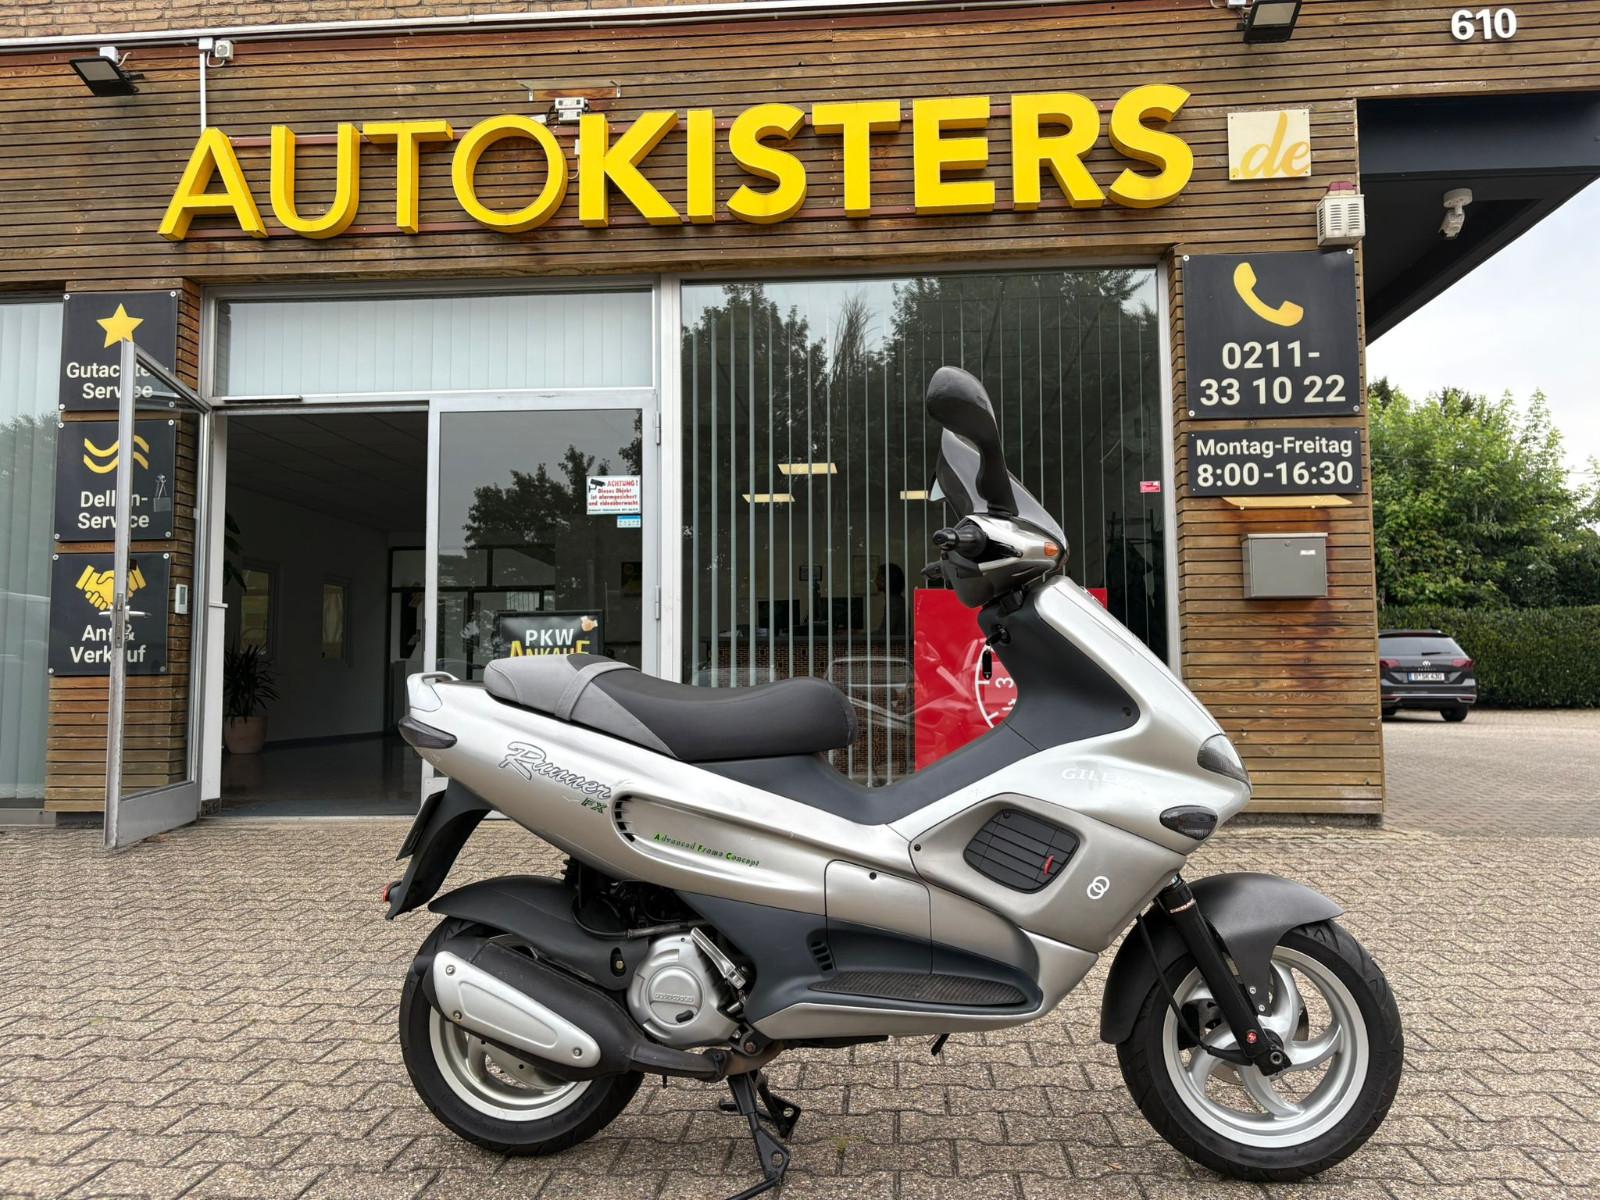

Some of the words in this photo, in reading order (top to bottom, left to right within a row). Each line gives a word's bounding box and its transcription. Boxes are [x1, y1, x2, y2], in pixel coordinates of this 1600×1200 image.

[1451, 8, 1517, 41] 610
[157, 84, 1194, 241] AUTOKISTERS
[1222, 340, 1320, 370] 0211-
[82, 383, 153, 399] Servce
[1200, 378, 1240, 406] 33
[1253, 376, 1293, 404] 10
[1303, 374, 1346, 403] 22
[1196, 436, 1353, 459] Montag-Freitag
[1197, 461, 1353, 487] 8:00-16:30
[80, 490, 149, 508] Delln-
[77, 512, 150, 529] Servce
[525, 628, 575, 646] PKW
[70, 644, 147, 664] Verkuf
[498, 741, 611, 800] Runner
[580, 797, 608, 814] FX
